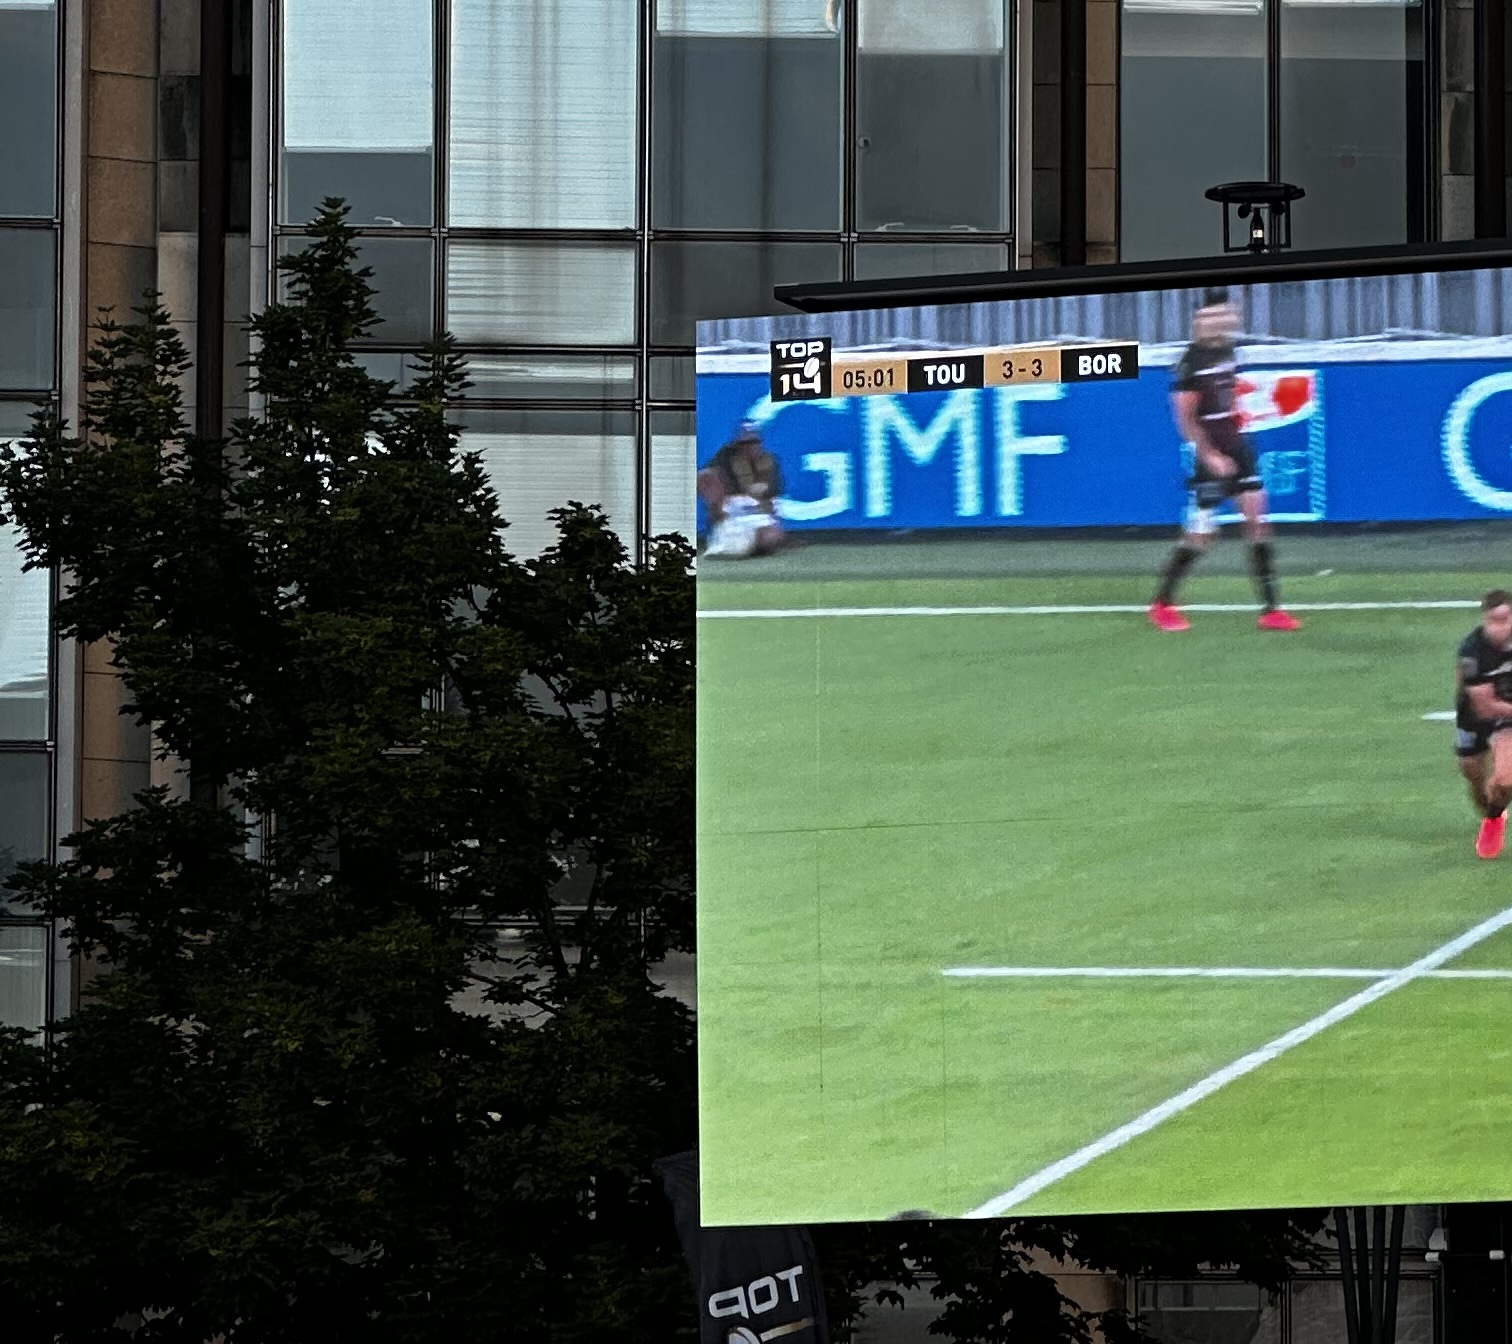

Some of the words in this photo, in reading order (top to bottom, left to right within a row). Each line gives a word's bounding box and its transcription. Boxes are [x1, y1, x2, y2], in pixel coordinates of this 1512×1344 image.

[775, 341, 823, 359] TOP
[779, 370, 822, 395] 14
[843, 369, 895, 389] 05:01
[923, 363, 966, 386] TOU
[1077, 353, 1123, 376] BOR
[745, 384, 1068, 519] GMF
